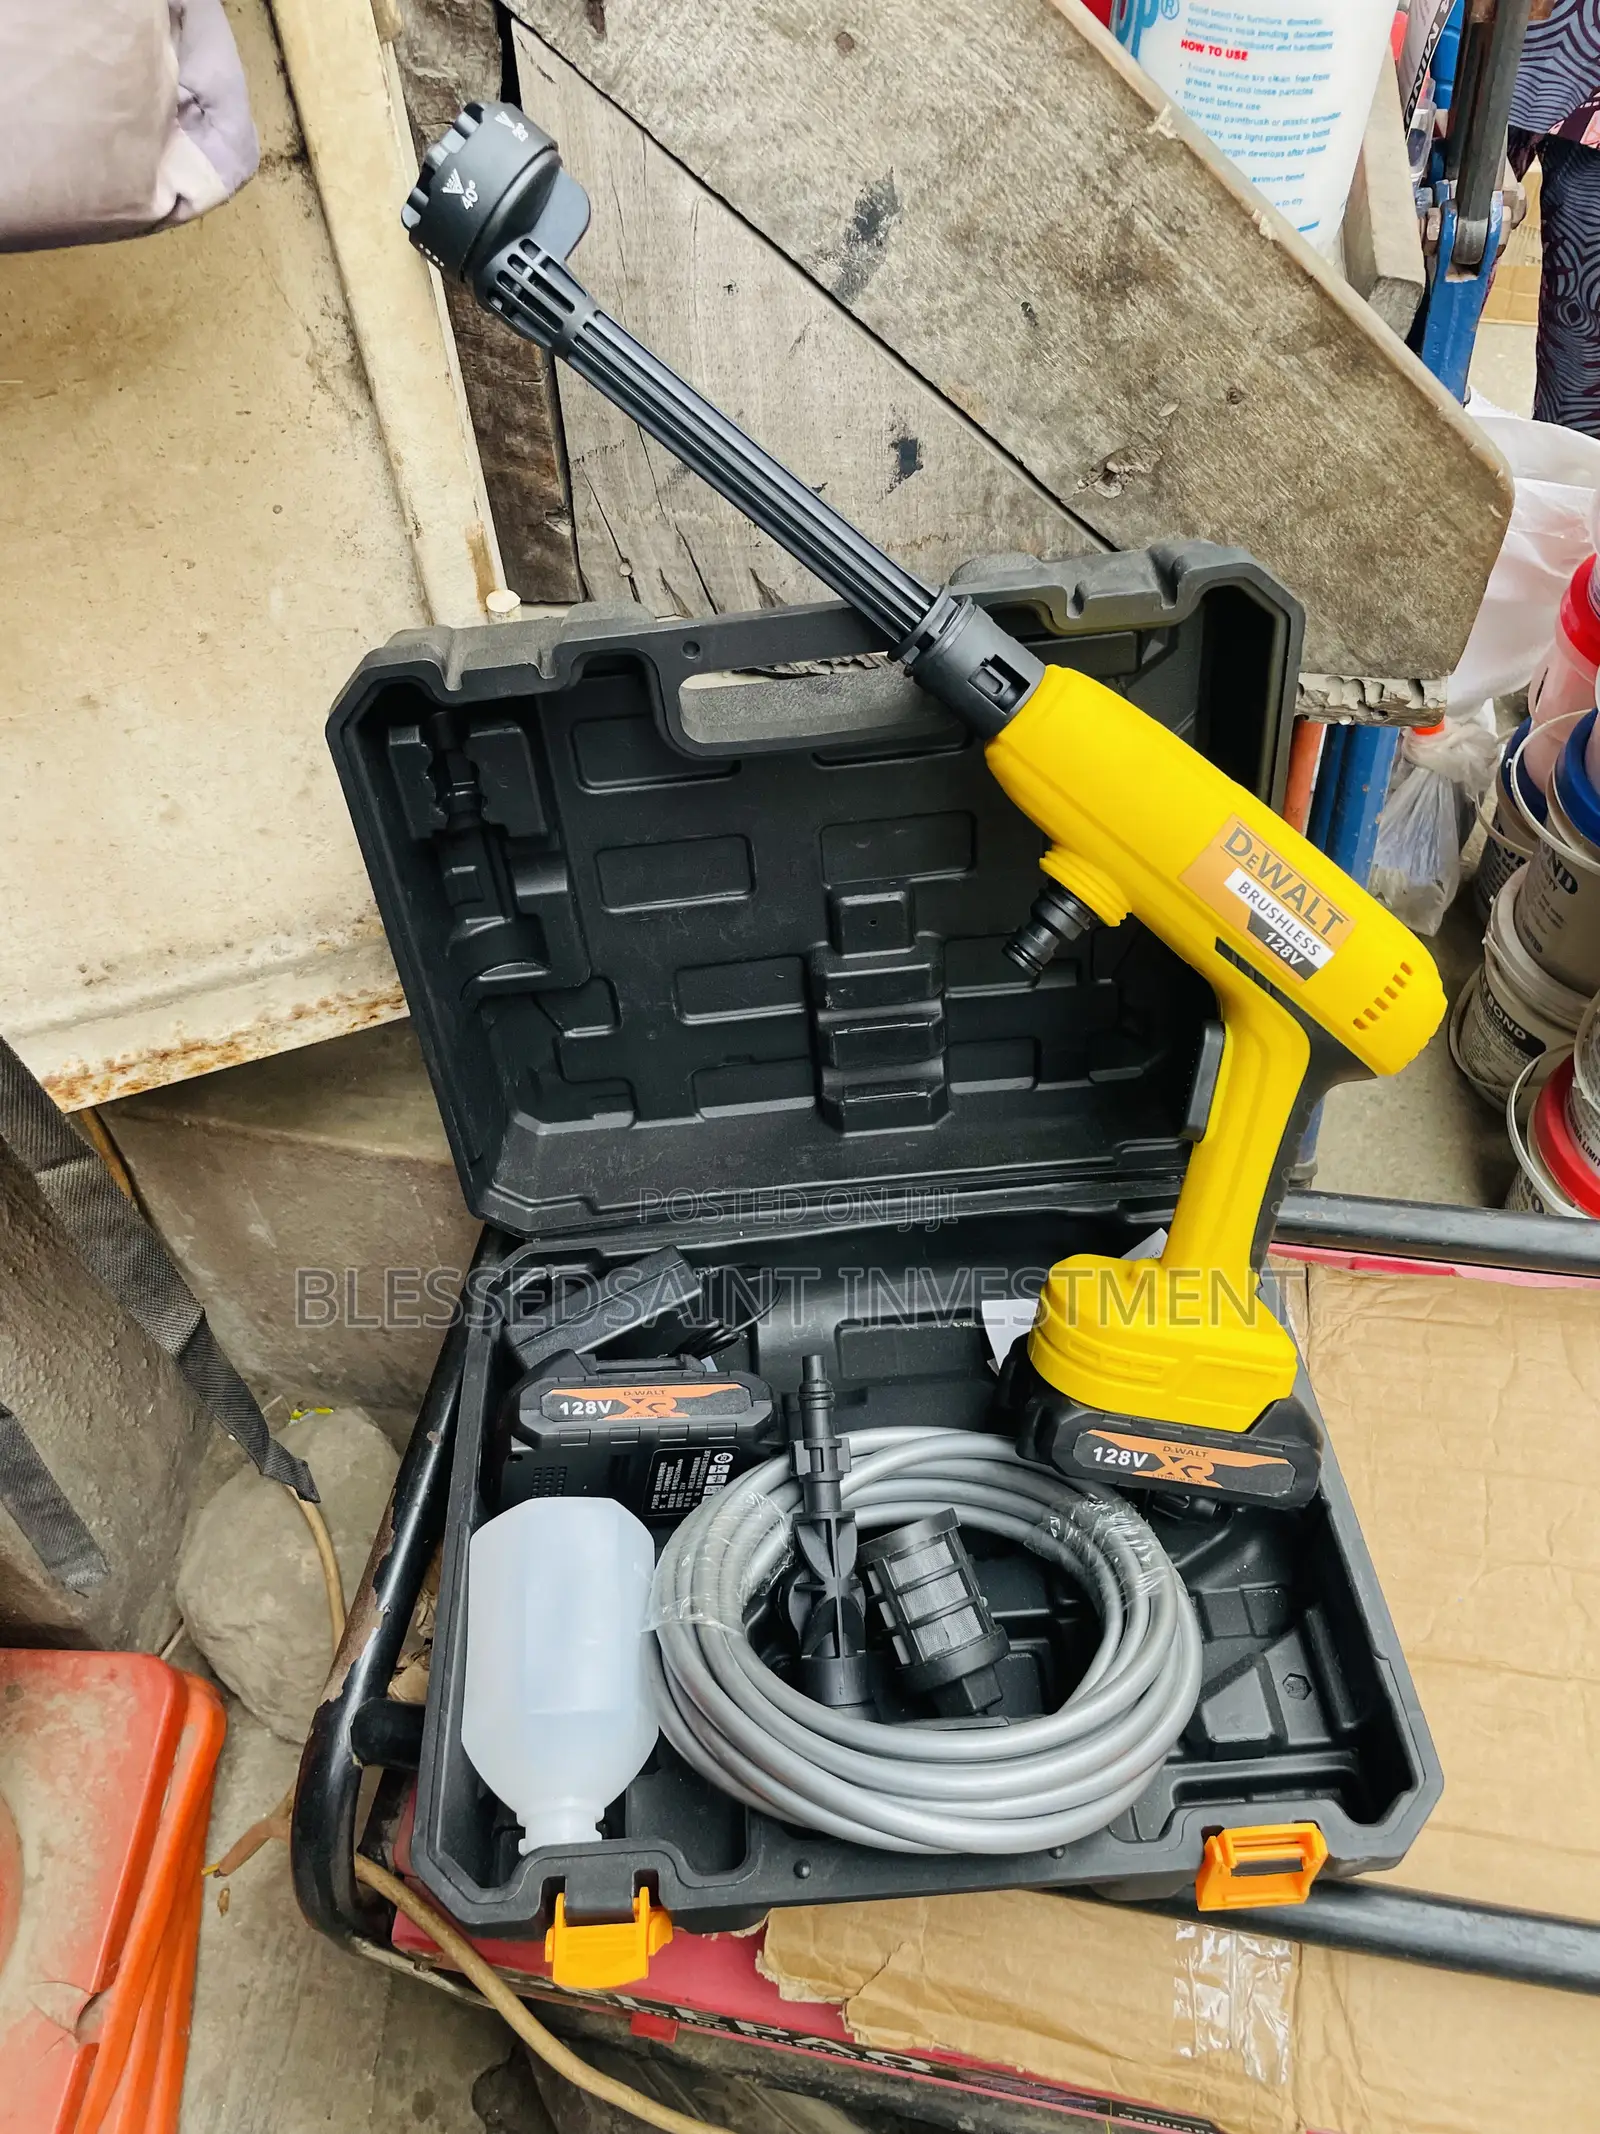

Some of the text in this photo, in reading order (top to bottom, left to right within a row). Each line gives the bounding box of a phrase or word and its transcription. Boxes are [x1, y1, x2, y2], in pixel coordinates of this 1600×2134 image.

[1180, 39, 1249, 62] HOW TO USE
[1217, 98, 1243, 110] before
[1228, 133, 1242, 141] use
[1238, 881, 1321, 957] BRUSHLESS
[1264, 930, 1305, 966] 128V
[559, 1399, 613, 1417] 128V
[1093, 1446, 1149, 1468] 128V
